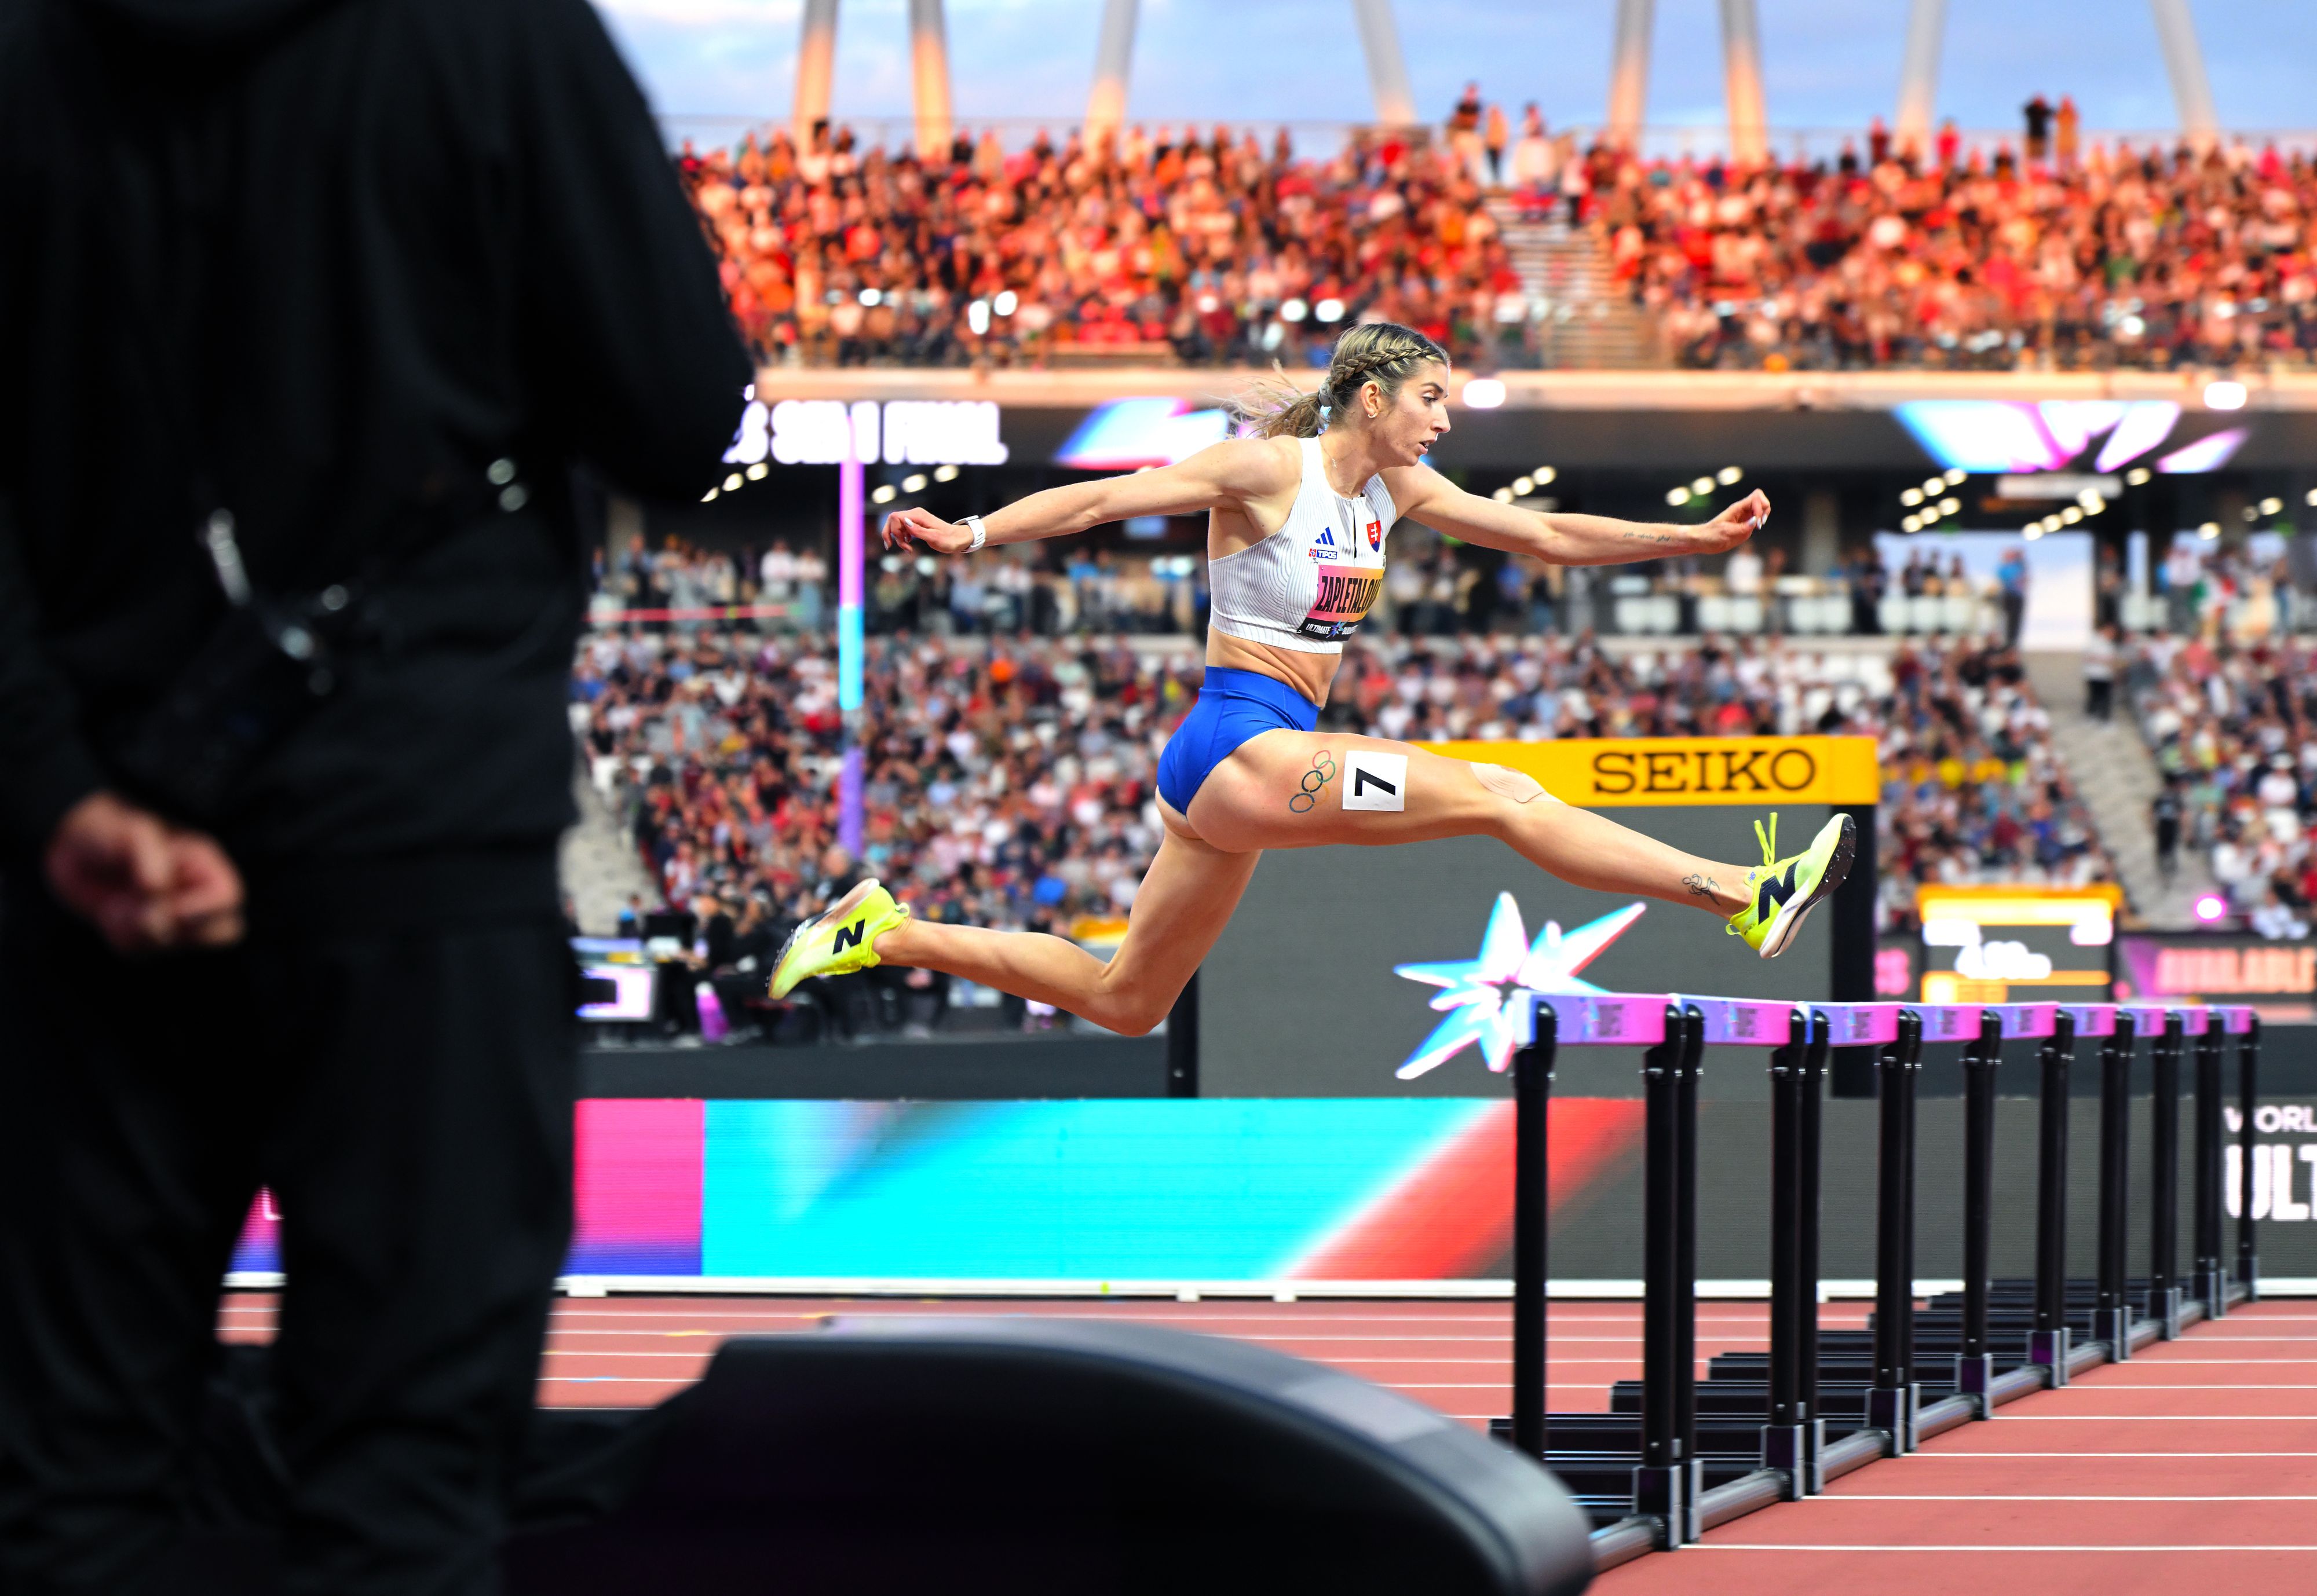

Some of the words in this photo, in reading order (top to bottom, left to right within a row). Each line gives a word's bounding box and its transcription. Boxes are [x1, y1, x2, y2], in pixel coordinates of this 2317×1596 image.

[1318, 551, 1337, 559] TIPOS
[1314, 576, 1383, 613] ZAPLETALOV
[1305, 623, 1331, 635] ULTIMATE
[1354, 767, 1396, 796] 7
[1593, 749, 1816, 794] SEIKO
